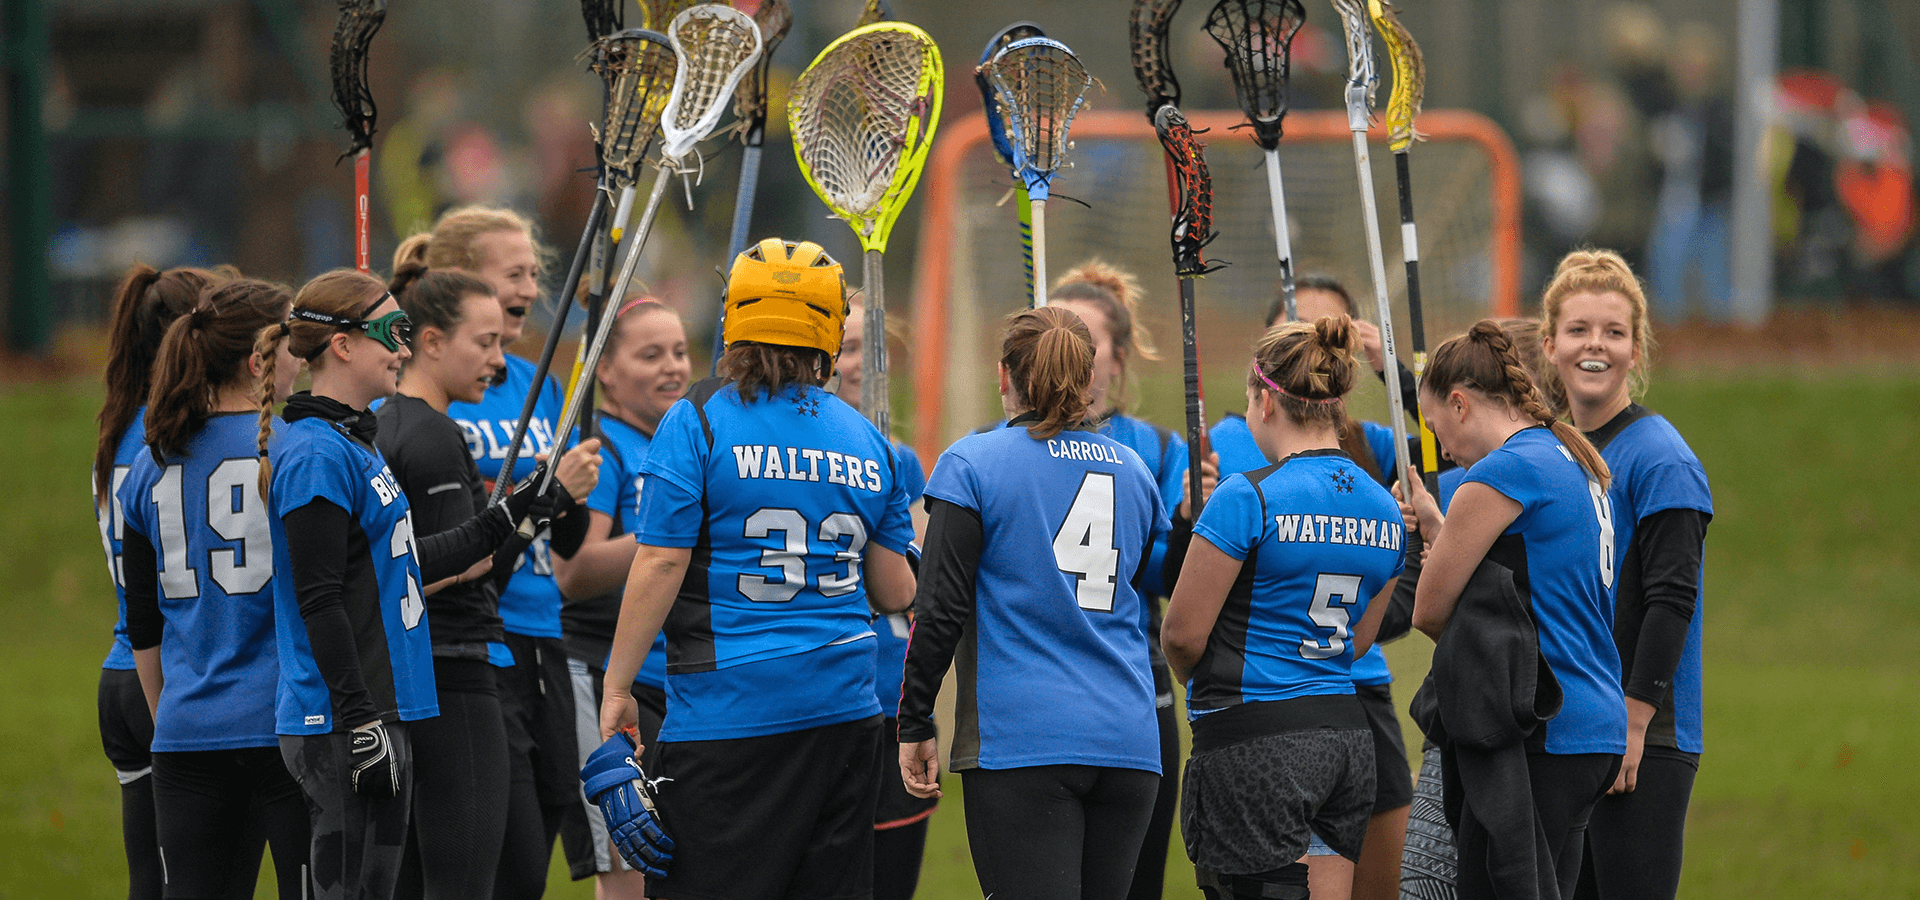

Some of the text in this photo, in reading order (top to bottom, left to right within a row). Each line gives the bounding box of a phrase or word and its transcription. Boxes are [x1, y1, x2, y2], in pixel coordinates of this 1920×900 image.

[732, 445, 882, 493] WALTERS
[1047, 439, 1123, 465] CARROLL
[151, 457, 273, 600] 19
[736, 507, 868, 603] 33
[1052, 470, 1120, 613] 4
[1275, 514, 1400, 551] WATERMAN
[1588, 479, 1615, 590] 8
[1299, 572, 1364, 661] 5
